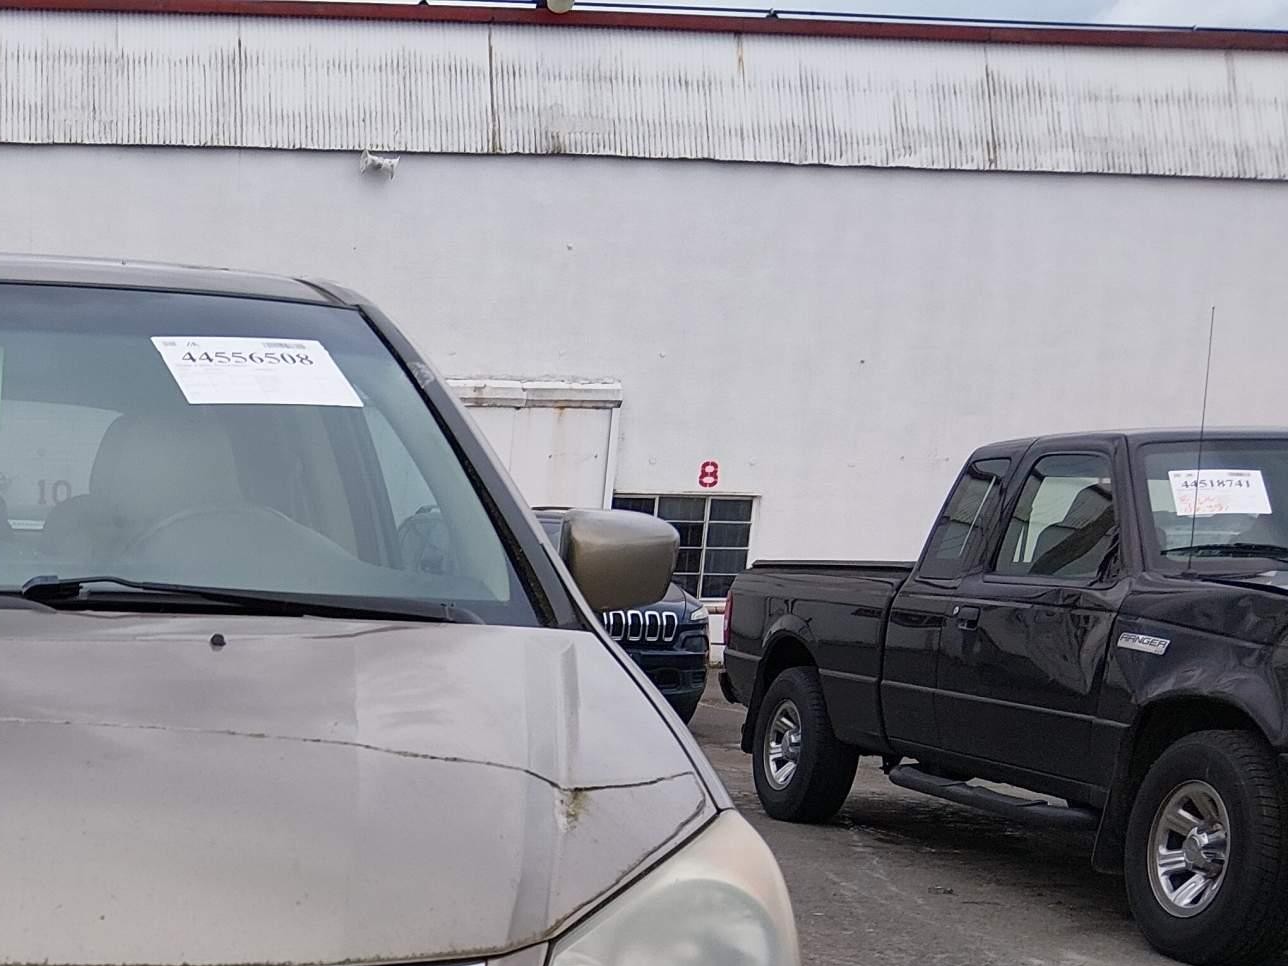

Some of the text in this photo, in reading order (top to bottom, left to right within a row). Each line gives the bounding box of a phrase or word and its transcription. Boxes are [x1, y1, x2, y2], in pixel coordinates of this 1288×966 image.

[182, 351, 314, 366] 44556508
[698, 461, 719, 487] 8
[37, 480, 72, 505] 10
[1119, 632, 1169, 648] RANGER
